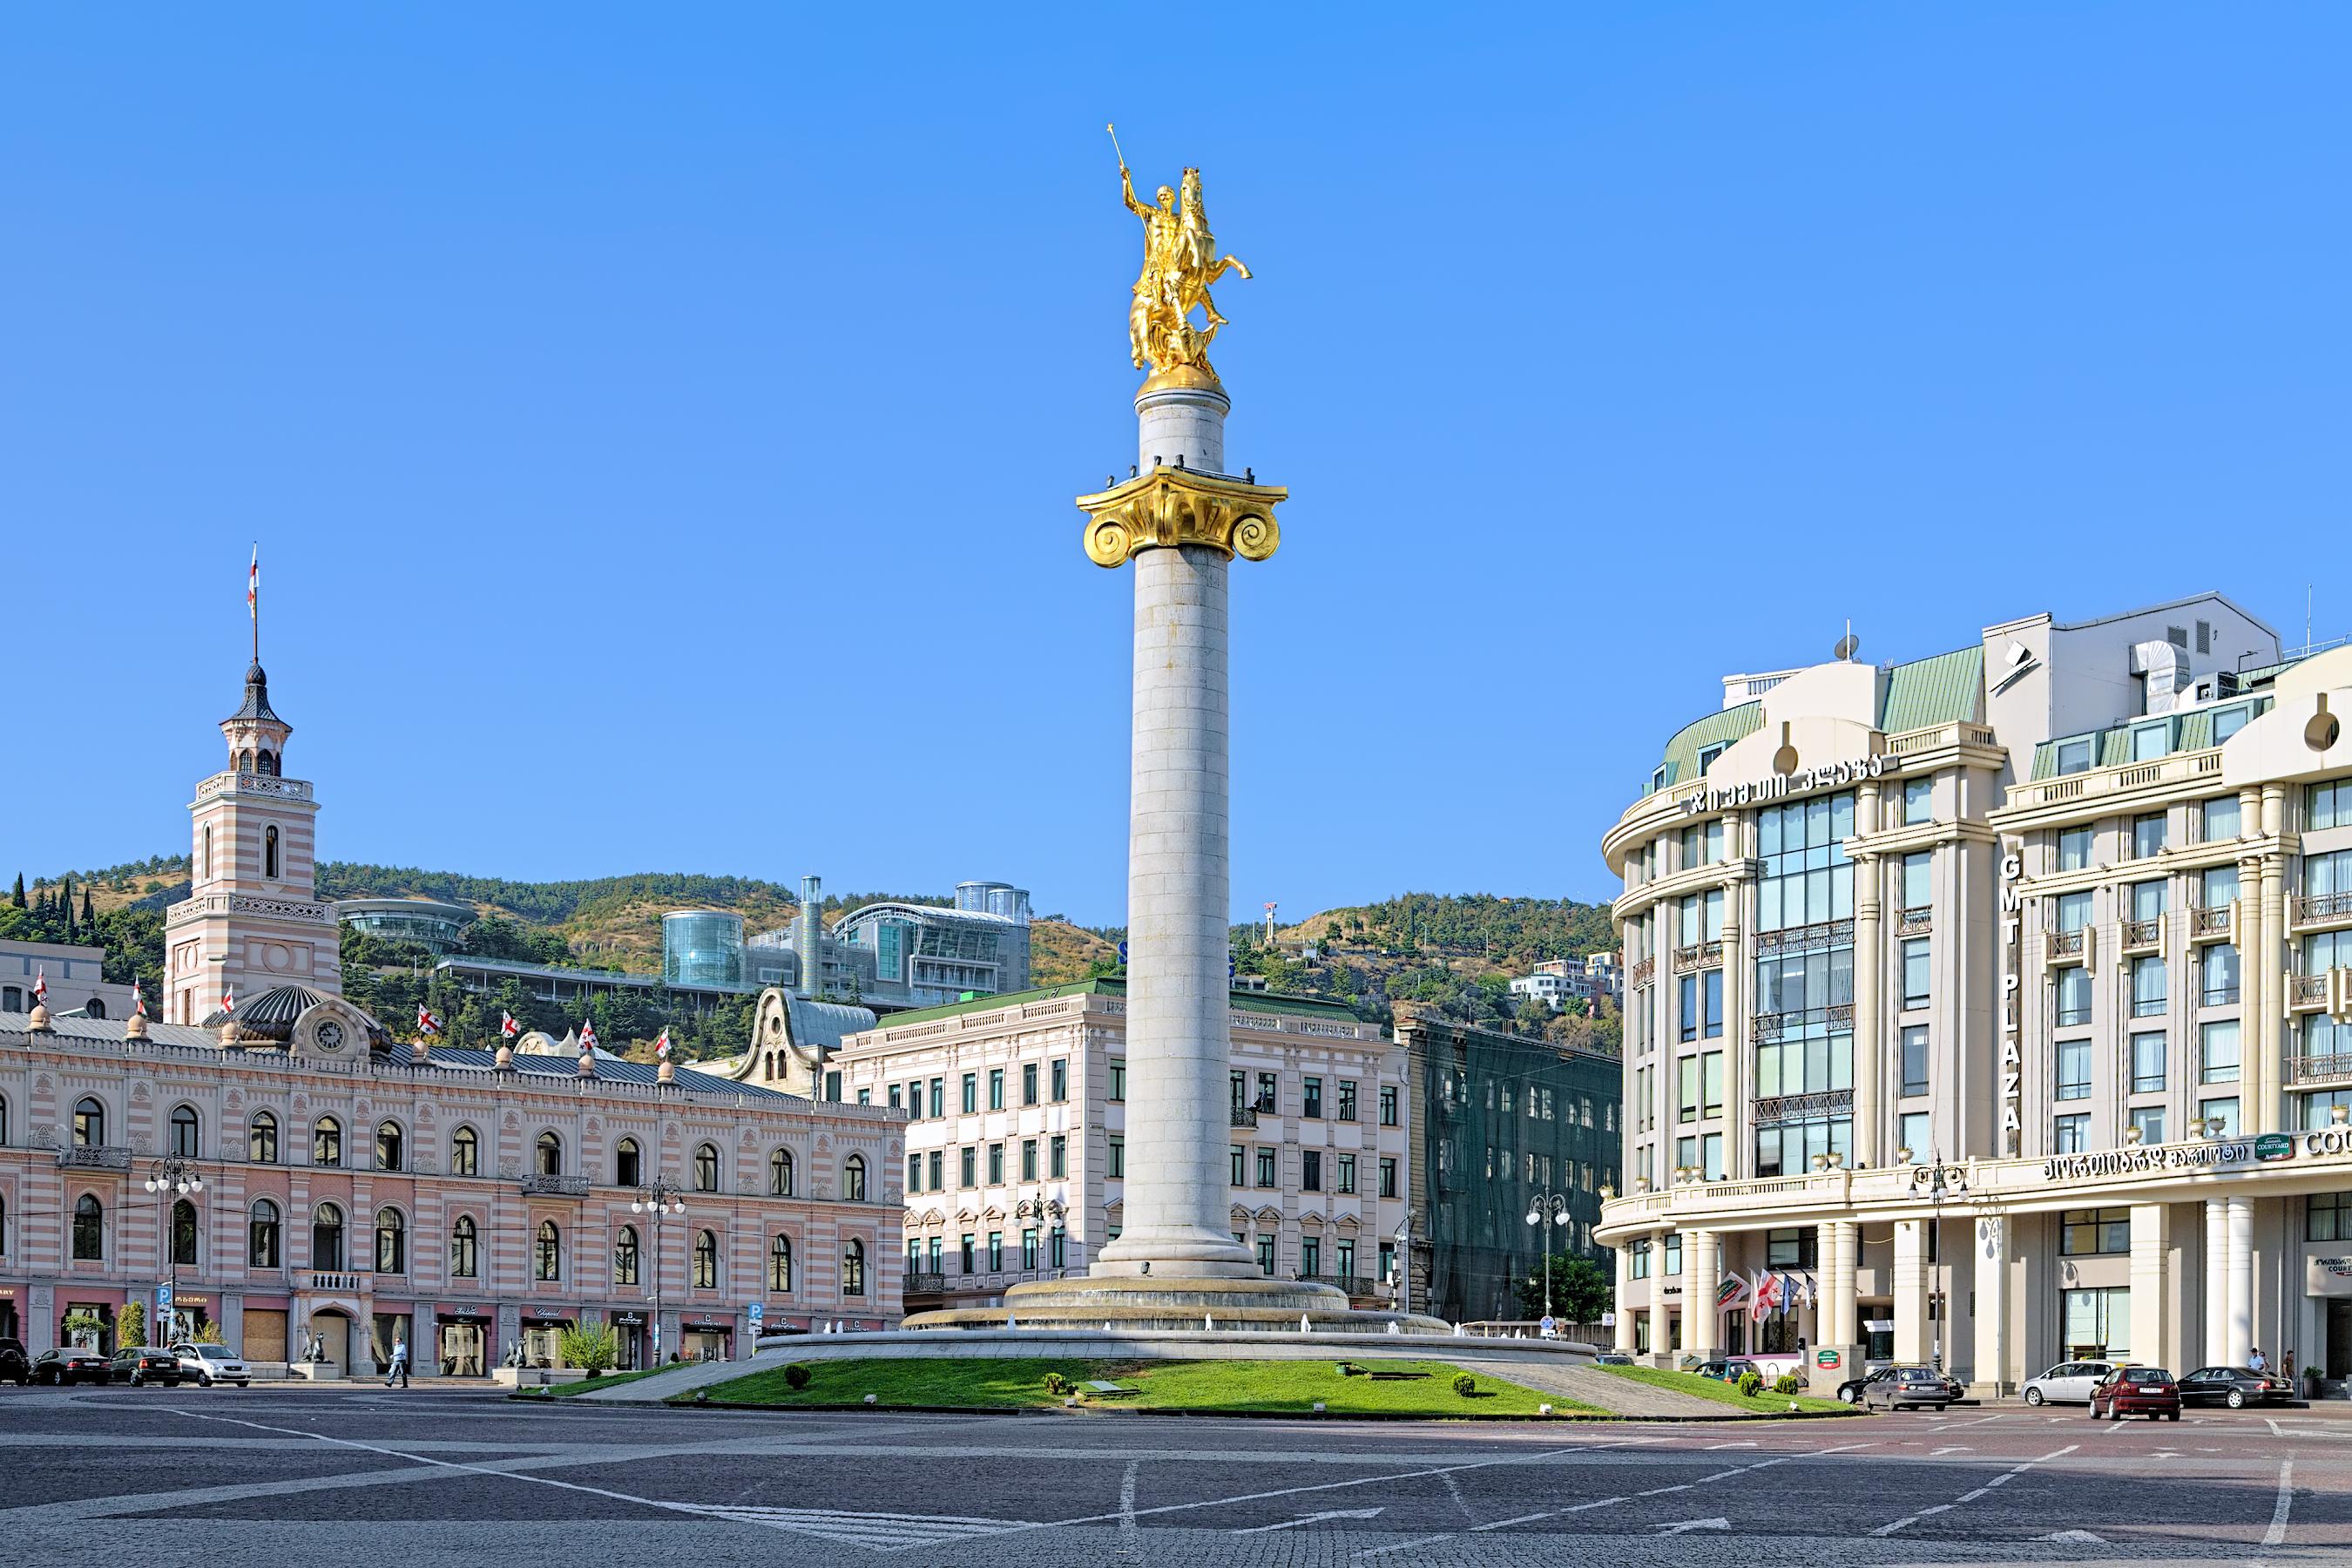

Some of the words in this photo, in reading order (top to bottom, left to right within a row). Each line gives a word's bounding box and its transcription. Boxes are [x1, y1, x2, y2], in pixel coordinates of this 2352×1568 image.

[1999, 855, 2021, 945] GMT
[2000, 974, 2021, 1131] PLAZA
[2257, 1142, 2289, 1151] COURTYARD
[159, 1288, 169, 1302] P
[751, 1304, 760, 1317] P
